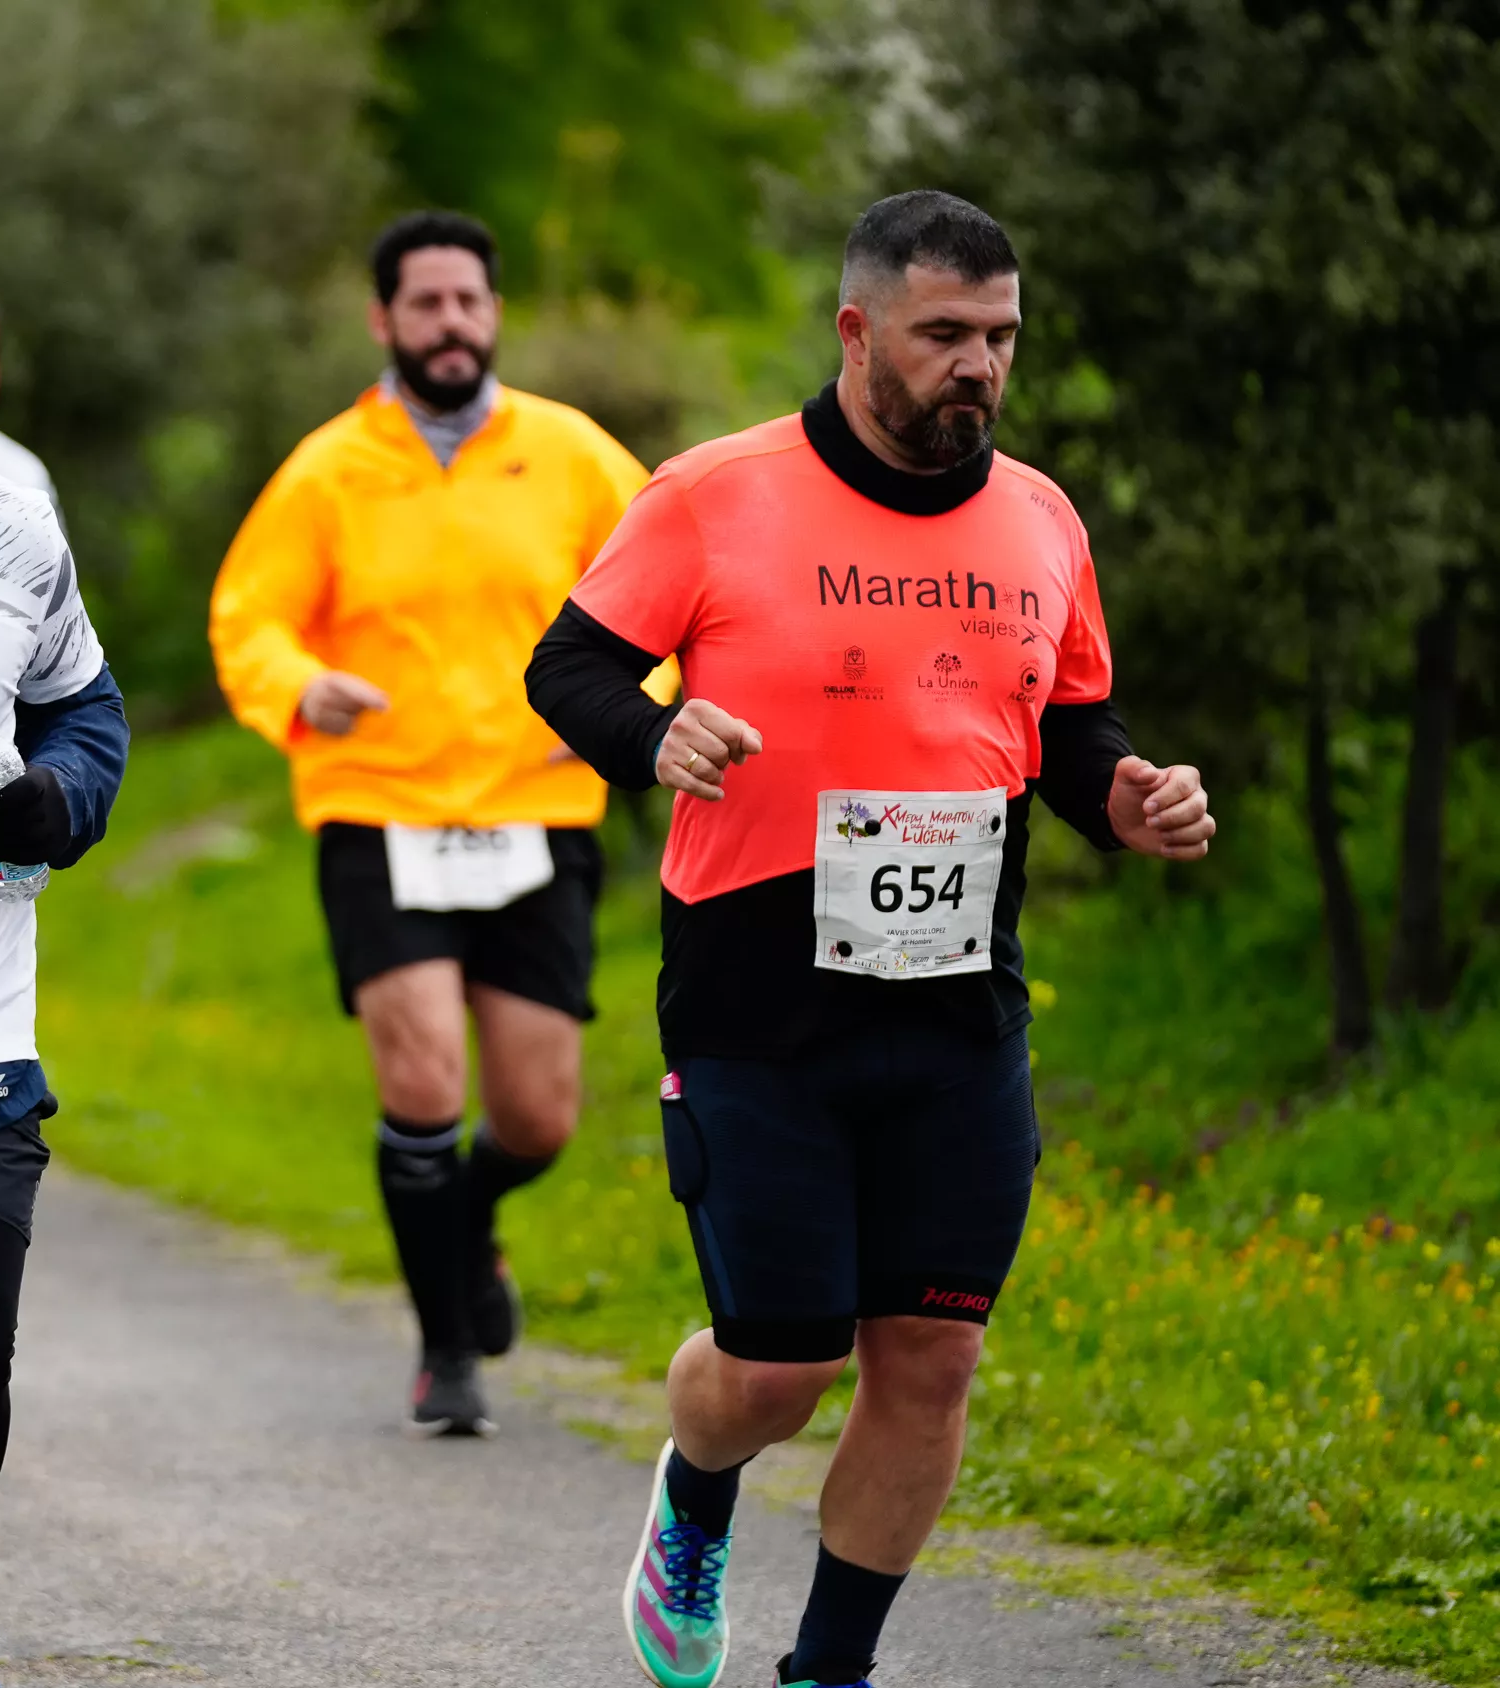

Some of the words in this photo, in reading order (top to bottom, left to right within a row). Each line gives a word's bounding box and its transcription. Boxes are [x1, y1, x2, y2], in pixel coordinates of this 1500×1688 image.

[960, 615, 1018, 640] viajes
[917, 675, 933, 688] La
[938, 675, 979, 689] Unión
[929, 809, 975, 825] MARATÓN
[901, 825, 961, 845] LUCENA
[870, 863, 966, 913] 654
[886, 928, 910, 936] JAVIER
[921, 1286, 991, 1311] HOKO
